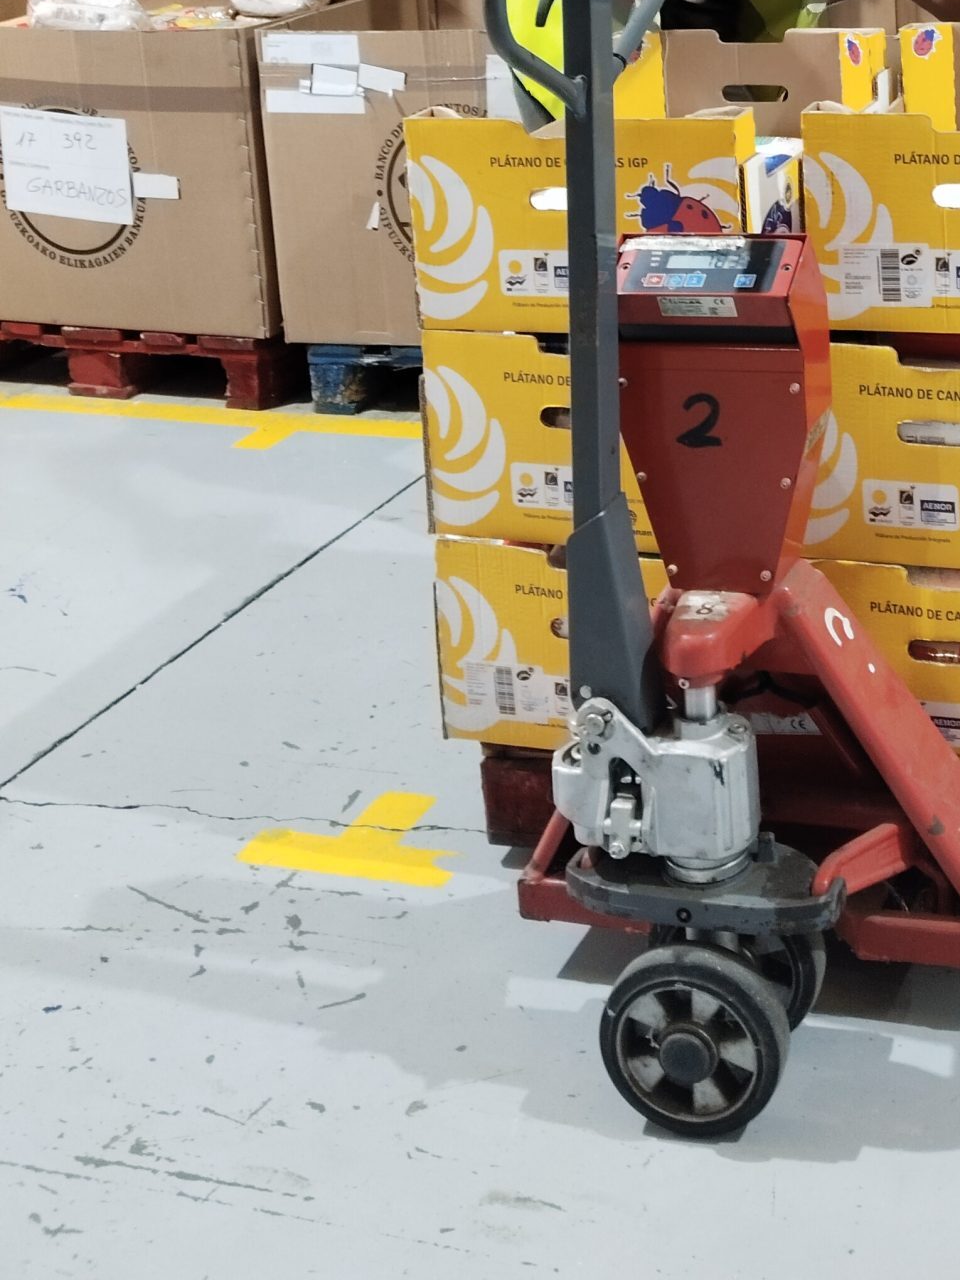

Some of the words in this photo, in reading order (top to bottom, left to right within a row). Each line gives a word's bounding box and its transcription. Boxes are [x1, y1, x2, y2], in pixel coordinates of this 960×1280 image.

[375, 138, 394, 181] BANCO
[490, 155, 542, 168] PLÁTANO
[545, 157, 561, 167] DE
[628, 158, 648, 168] IGP
[894, 152, 950, 166] PLÁTANO
[59, 243, 127, 269] ELIKAGAIEN
[125, 197, 147, 247] BANKUA
[503, 371, 554, 385] PLÁTANO
[859, 383, 914, 400] PLÁTANO
[917, 388, 934, 401] DE
[676, 393, 722, 448] 2
[922, 502, 952, 512] AENOR
[515, 584, 563, 600] PLÁTANO
[869, 601, 923, 618] PLÁTANO
[927, 608, 943, 621] DE
